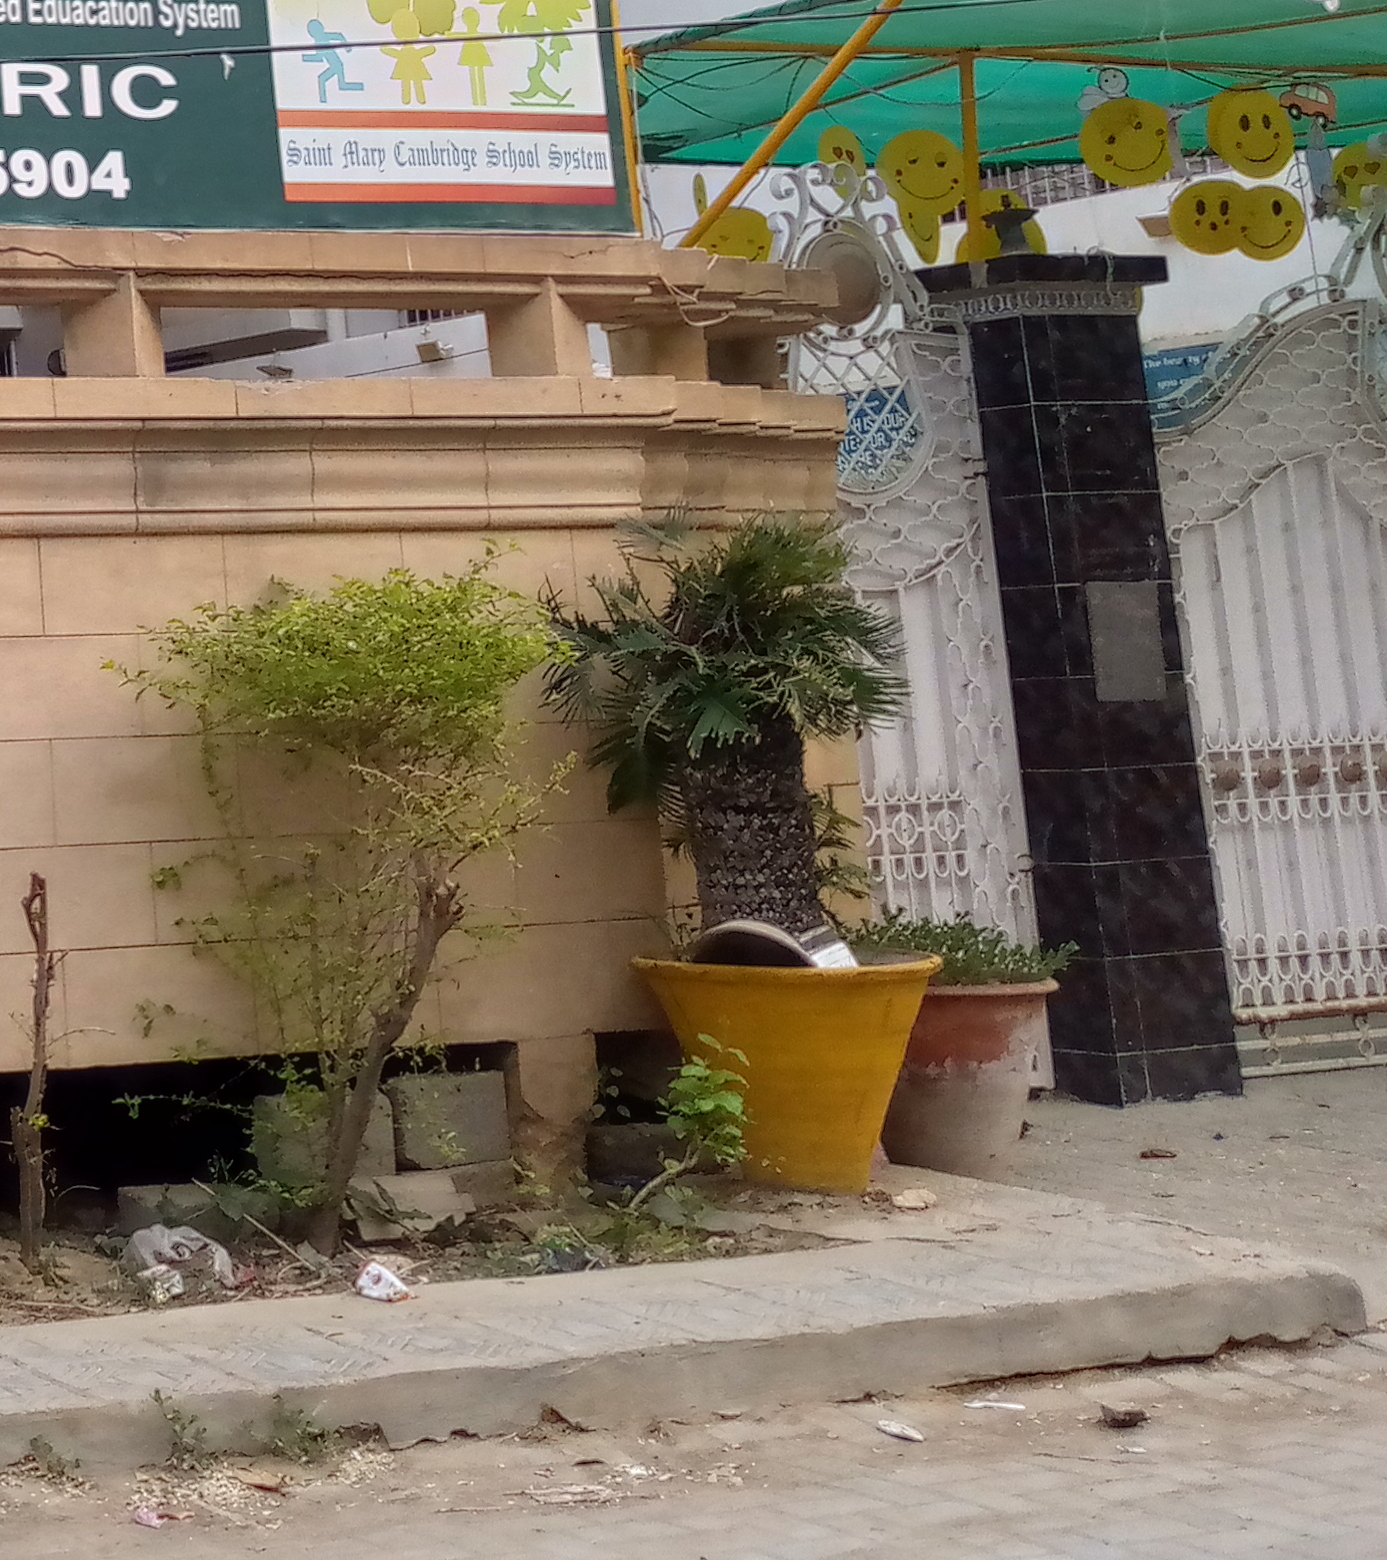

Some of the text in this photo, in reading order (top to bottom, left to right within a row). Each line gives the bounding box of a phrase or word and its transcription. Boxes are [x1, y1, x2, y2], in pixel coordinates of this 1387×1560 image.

[285, 138, 609, 176] Saint Mary Cambridge School System
